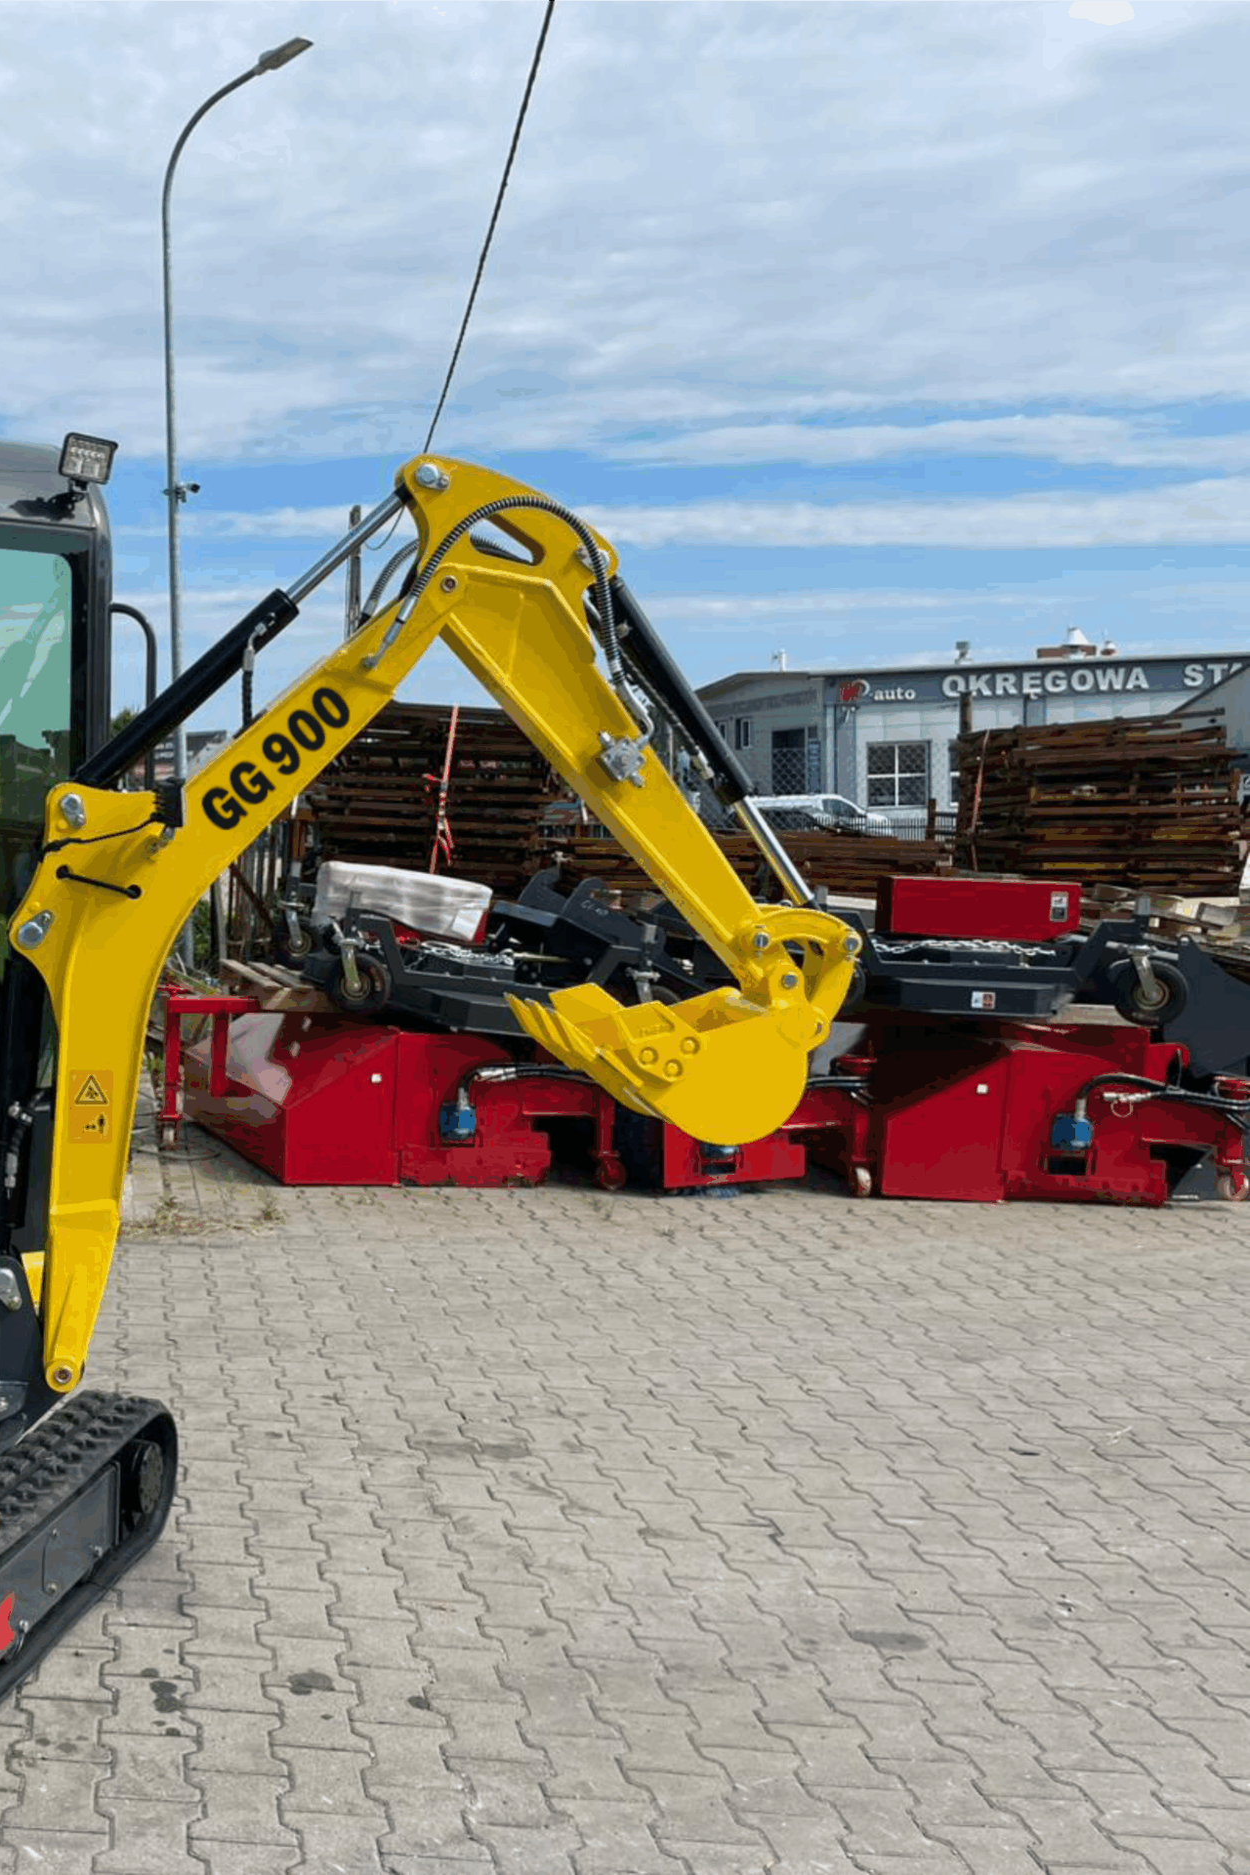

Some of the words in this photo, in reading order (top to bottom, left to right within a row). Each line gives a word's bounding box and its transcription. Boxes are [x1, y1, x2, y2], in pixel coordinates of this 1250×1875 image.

[942, 667, 1149, 700] OKRĘGOWA
[202, 761, 276, 830] GG
[262, 687, 350, 775] 900
